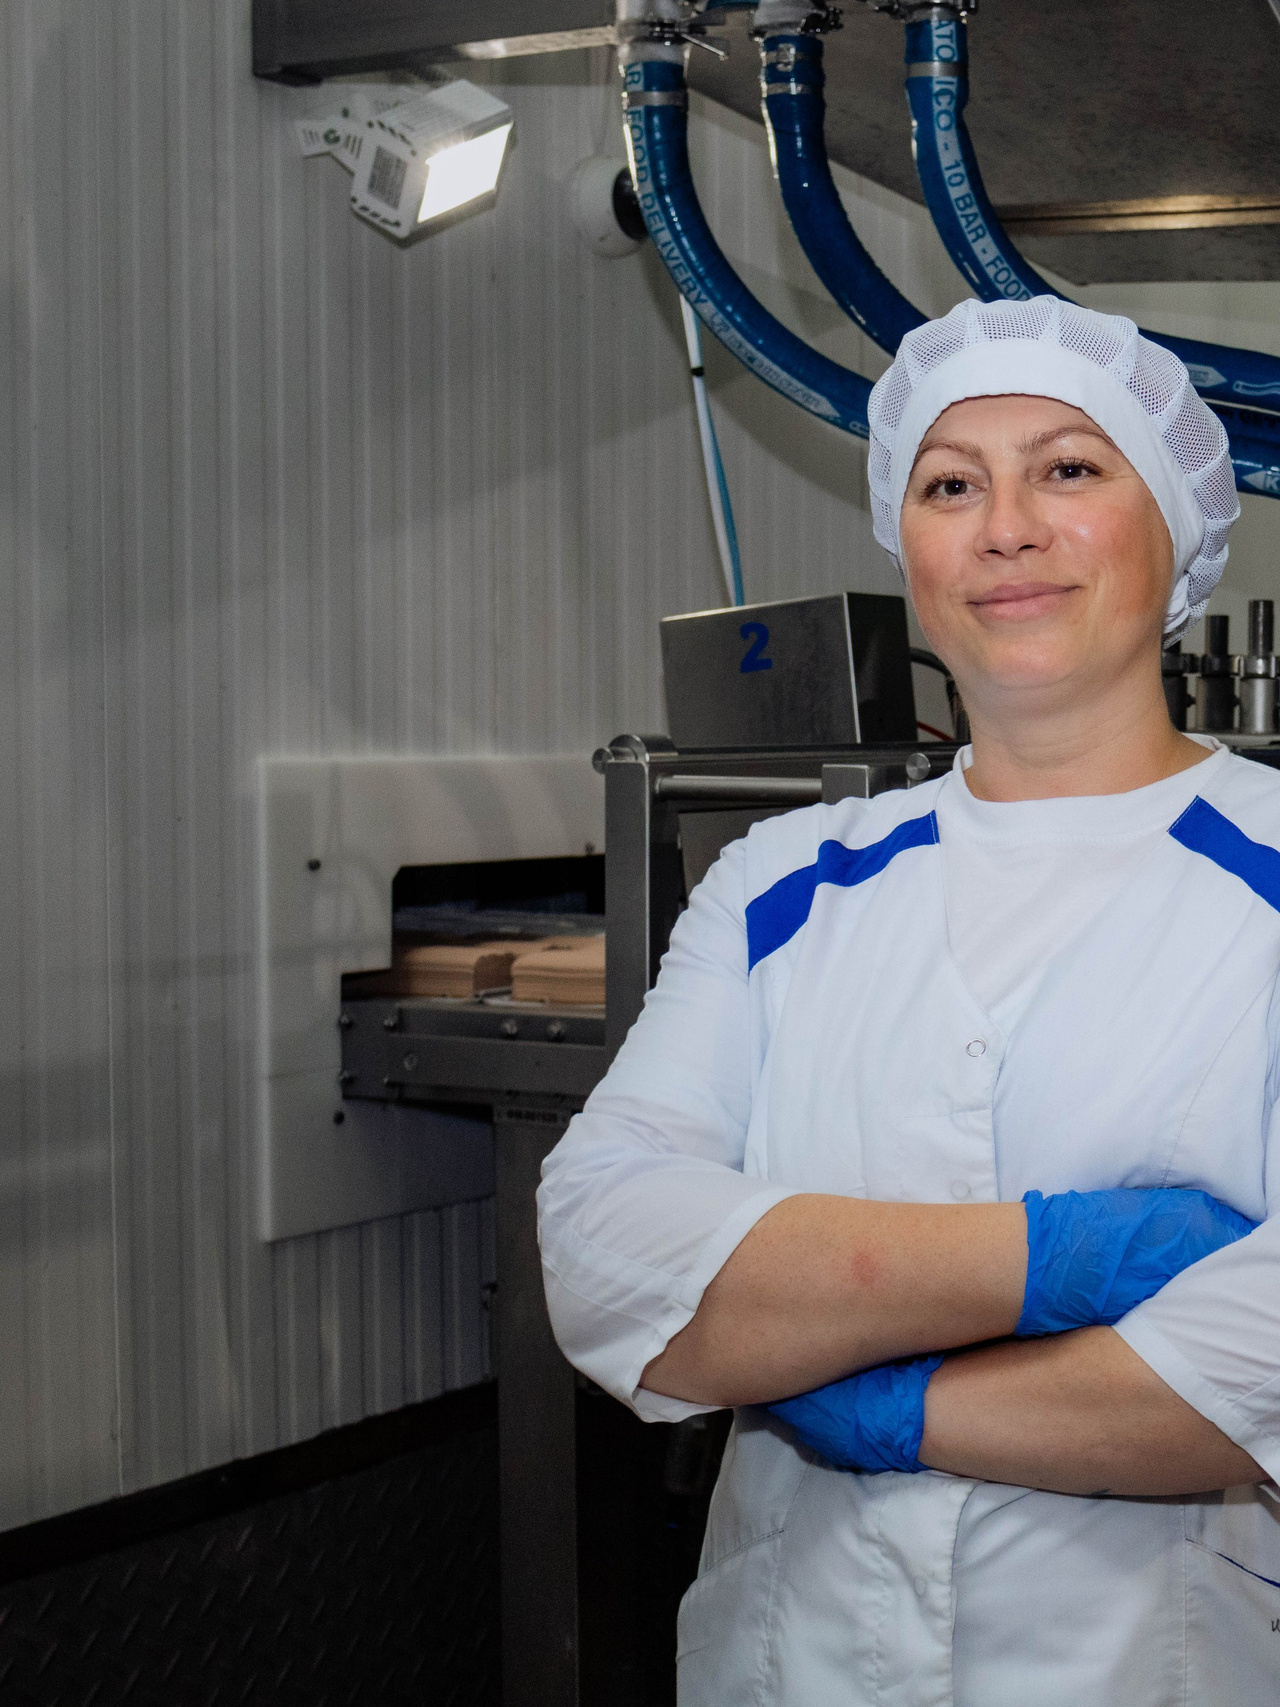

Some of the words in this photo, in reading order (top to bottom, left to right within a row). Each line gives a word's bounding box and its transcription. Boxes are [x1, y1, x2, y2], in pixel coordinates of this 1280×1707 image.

[934, 20, 957, 131] ATOICO
[943, 158, 966, 188] 10
[626, 109, 649, 183] FOOD
[641, 191, 708, 303] DELIVERY
[954, 193, 988, 244] BAR
[739, 621, 773, 674] 2
